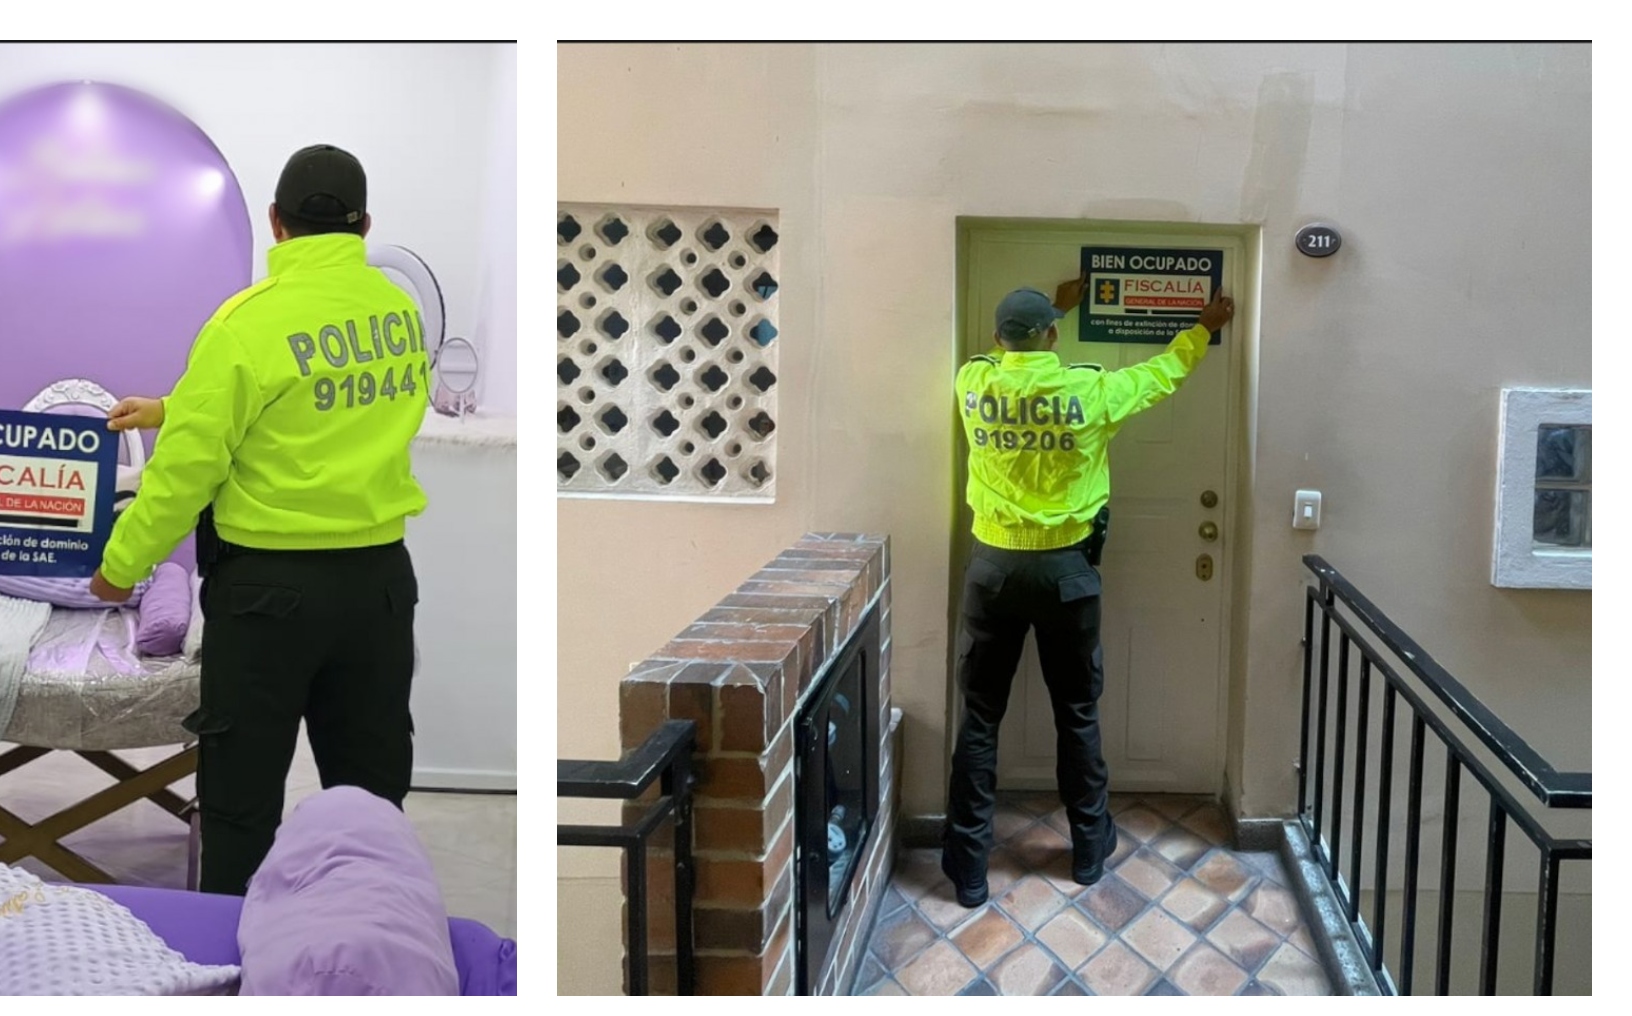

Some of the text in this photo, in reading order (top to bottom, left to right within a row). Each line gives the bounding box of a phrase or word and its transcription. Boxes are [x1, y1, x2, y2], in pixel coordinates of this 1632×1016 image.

[1308, 234, 1330, 248] 211
[1091, 254, 1212, 271] BIEN OCUPADO
[1124, 278, 1204, 294] FISCALÍA
[965, 391, 1086, 425] POLICIA
[974, 427, 1075, 452] 919206
[6, 497, 21, 508] DE
[24, 499, 38, 509] LA
[23, 536, 39, 548] de
[40, 537, 89, 551] dominio
[1, 549, 16, 561] de
[19, 550, 30, 562] la
[32, 551, 57, 564] SAE.
